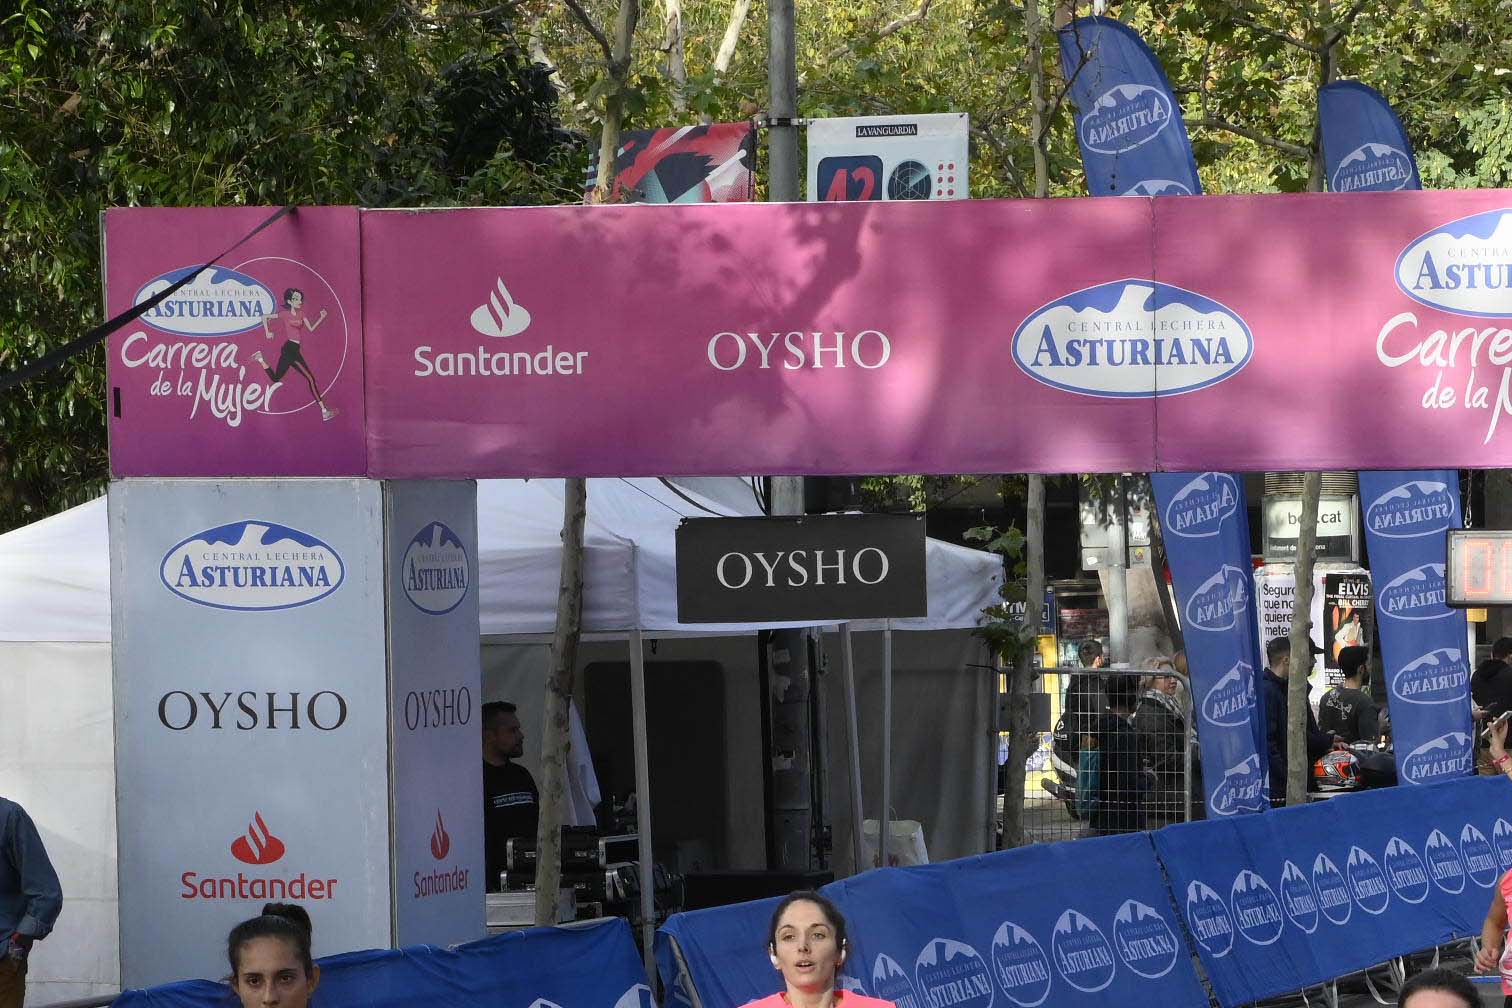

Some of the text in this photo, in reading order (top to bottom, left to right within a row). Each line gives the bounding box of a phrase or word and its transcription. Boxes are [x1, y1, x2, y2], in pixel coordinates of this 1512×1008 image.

[868, 125, 916, 136] VANGUARDIA
[145, 290, 265, 318] ASTURIANA
[172, 288, 211, 297] ENTRAL
[1068, 319, 1227, 333] CENTRAL LECHERA
[120, 331, 240, 369] Carrera
[414, 345, 589, 377] Santander
[706, 330, 892, 372] OYSHO
[1031, 324, 1235, 368] ASTURIANA
[150, 365, 284, 428] de la Mujer
[1422, 374, 1457, 410] de
[1463, 367, 1489, 409] la
[174, 553, 331, 588] ASTURIANA
[202, 551, 325, 562] CENTRAL LECHERA
[716, 547, 890, 589] OYSHO
[407, 557, 466, 592] ASTURIANA
[1338, 583, 1369, 596] ELVIS
[1264, 601, 1280, 612] que
[157, 690, 348, 731] OYSHO
[404, 686, 472, 731] OYSHO
[181, 871, 338, 900] Santander
[413, 865, 469, 899] Santander
[1000, 957, 1048, 989] ASTURIANA
[1058, 943, 1111, 976] ASTURIANA
